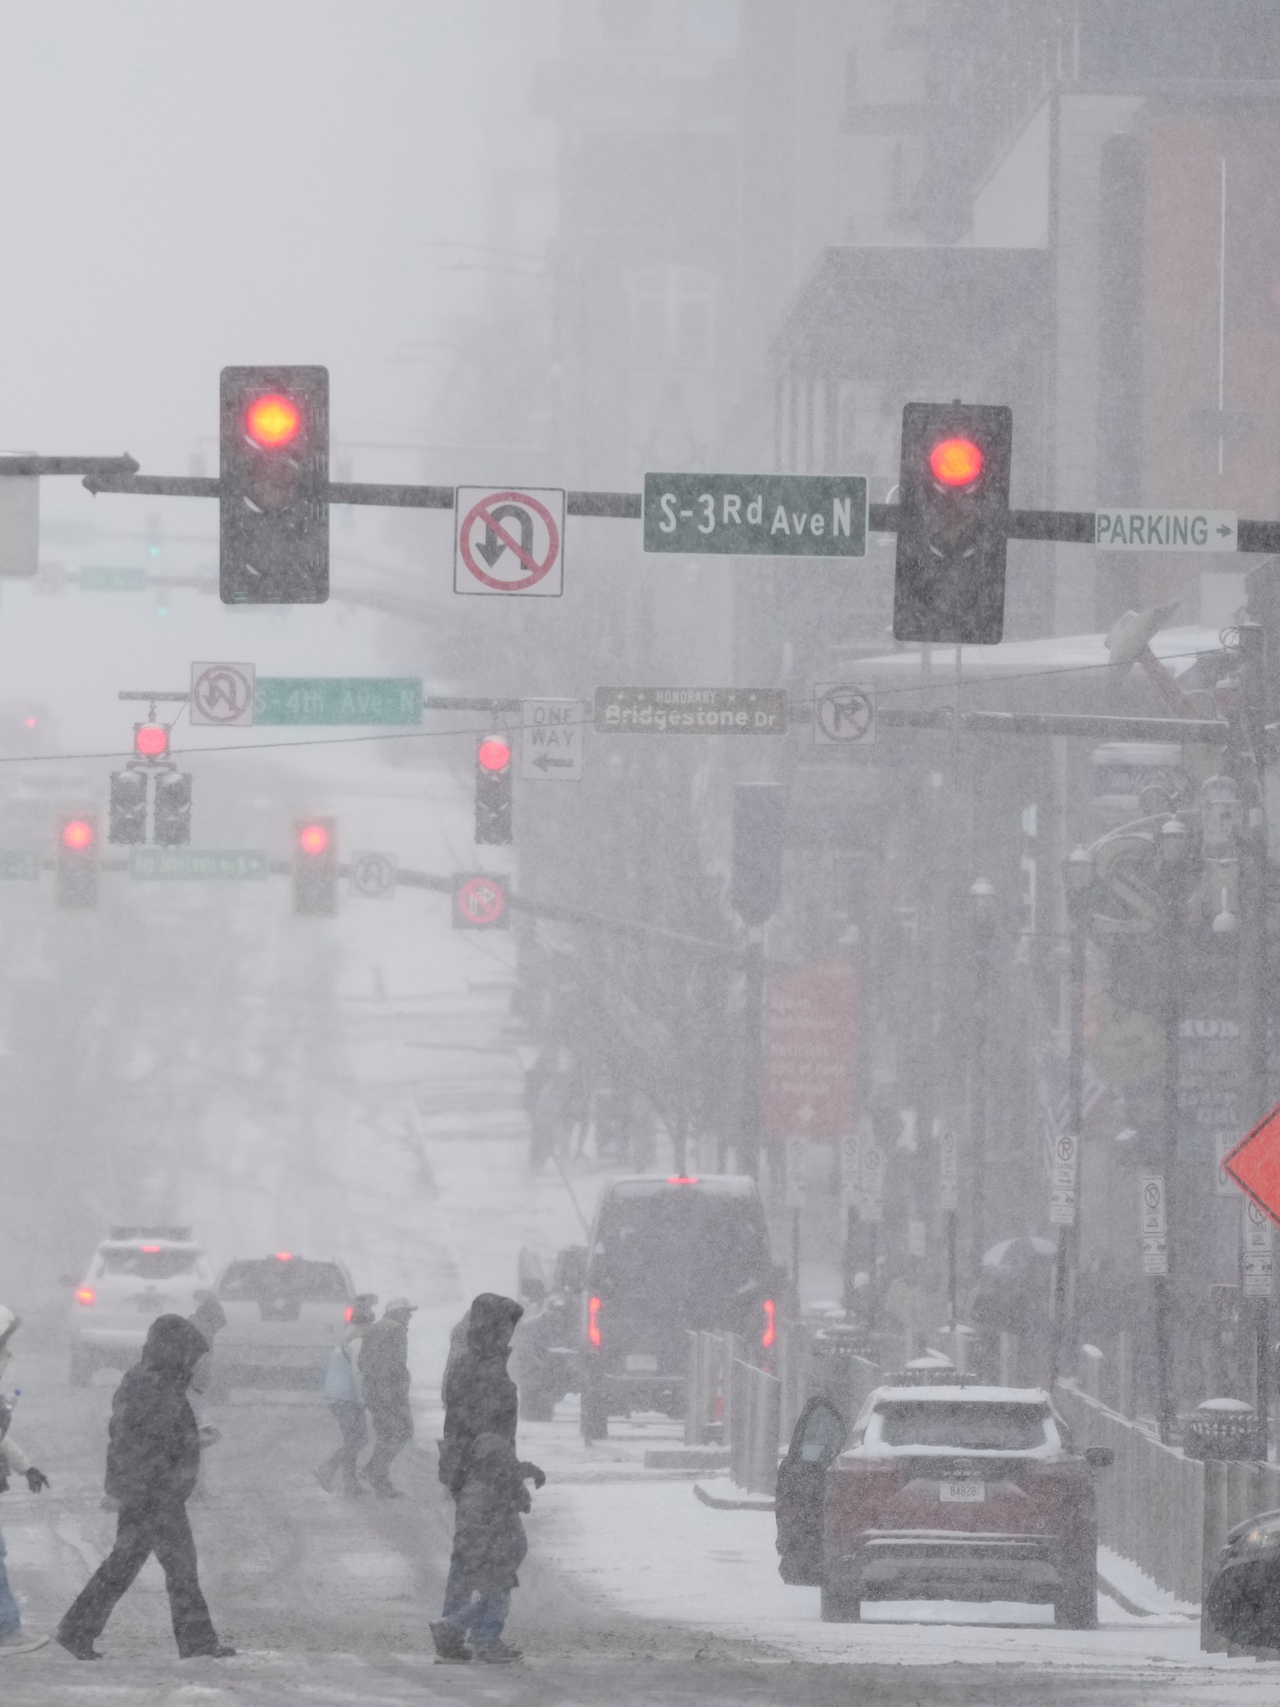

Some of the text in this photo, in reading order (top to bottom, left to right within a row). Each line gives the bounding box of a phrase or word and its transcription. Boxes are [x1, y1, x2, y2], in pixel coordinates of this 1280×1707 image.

[771, 504, 825, 535] Ave
[832, 497, 852, 537] N
[1096, 513, 1209, 546] PARKING
[656, 690, 717, 705] HONORARY
[533, 706, 575, 726] ONE
[605, 704, 777, 731] Bridgestone Dr
[530, 728, 576, 748] WAY
